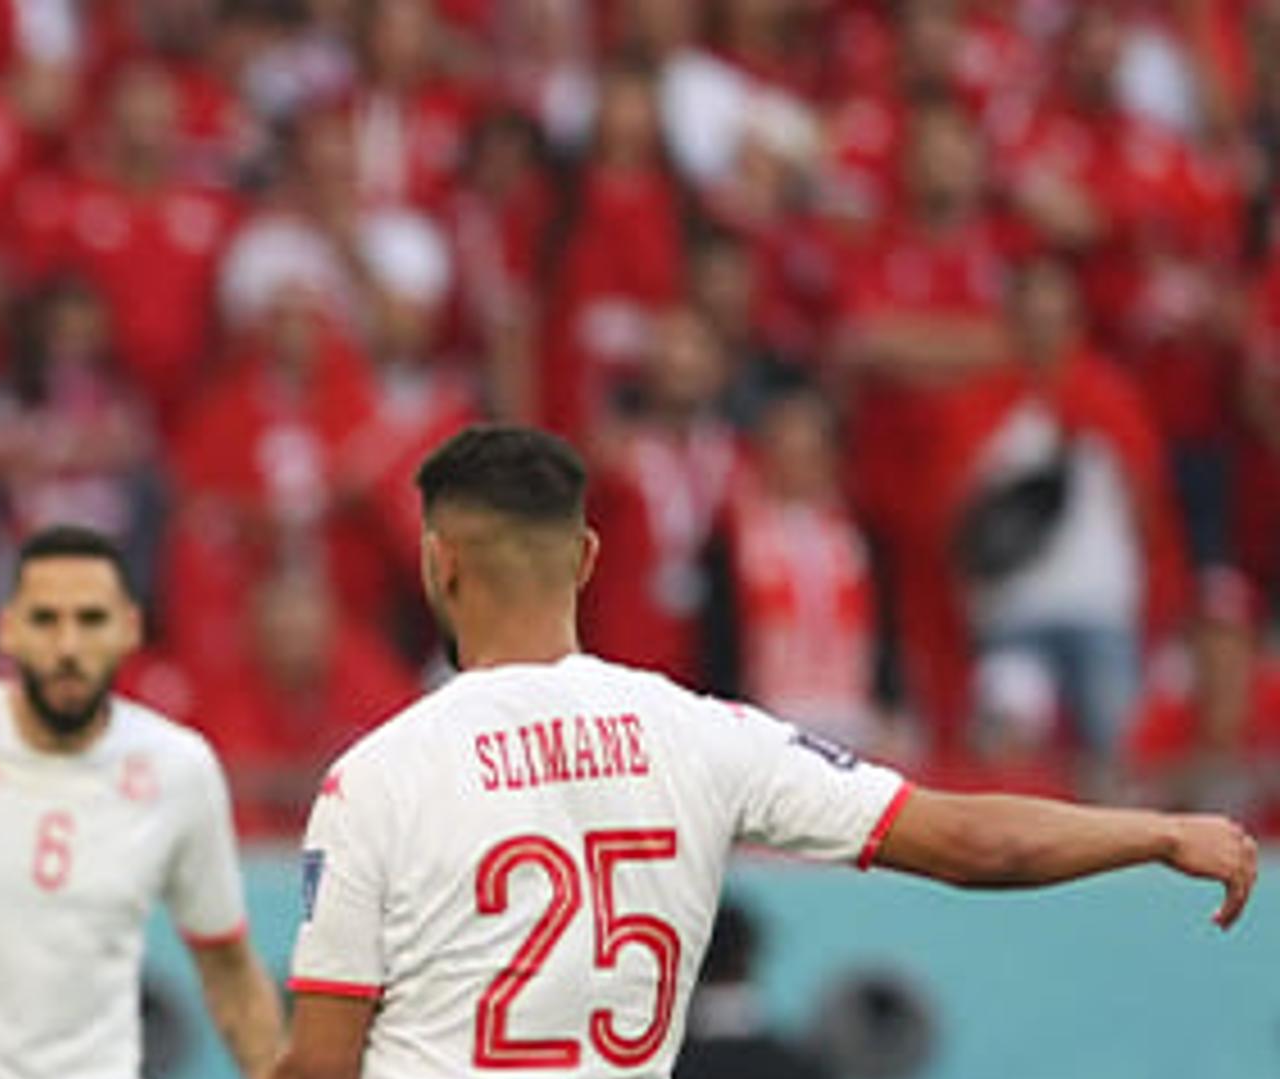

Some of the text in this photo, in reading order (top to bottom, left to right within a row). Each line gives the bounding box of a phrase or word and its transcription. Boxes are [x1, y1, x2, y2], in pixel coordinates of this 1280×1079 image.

[475, 714, 648, 791] SLIMANE
[33, 808, 78, 895] 6
[473, 828, 680, 1068] 25
